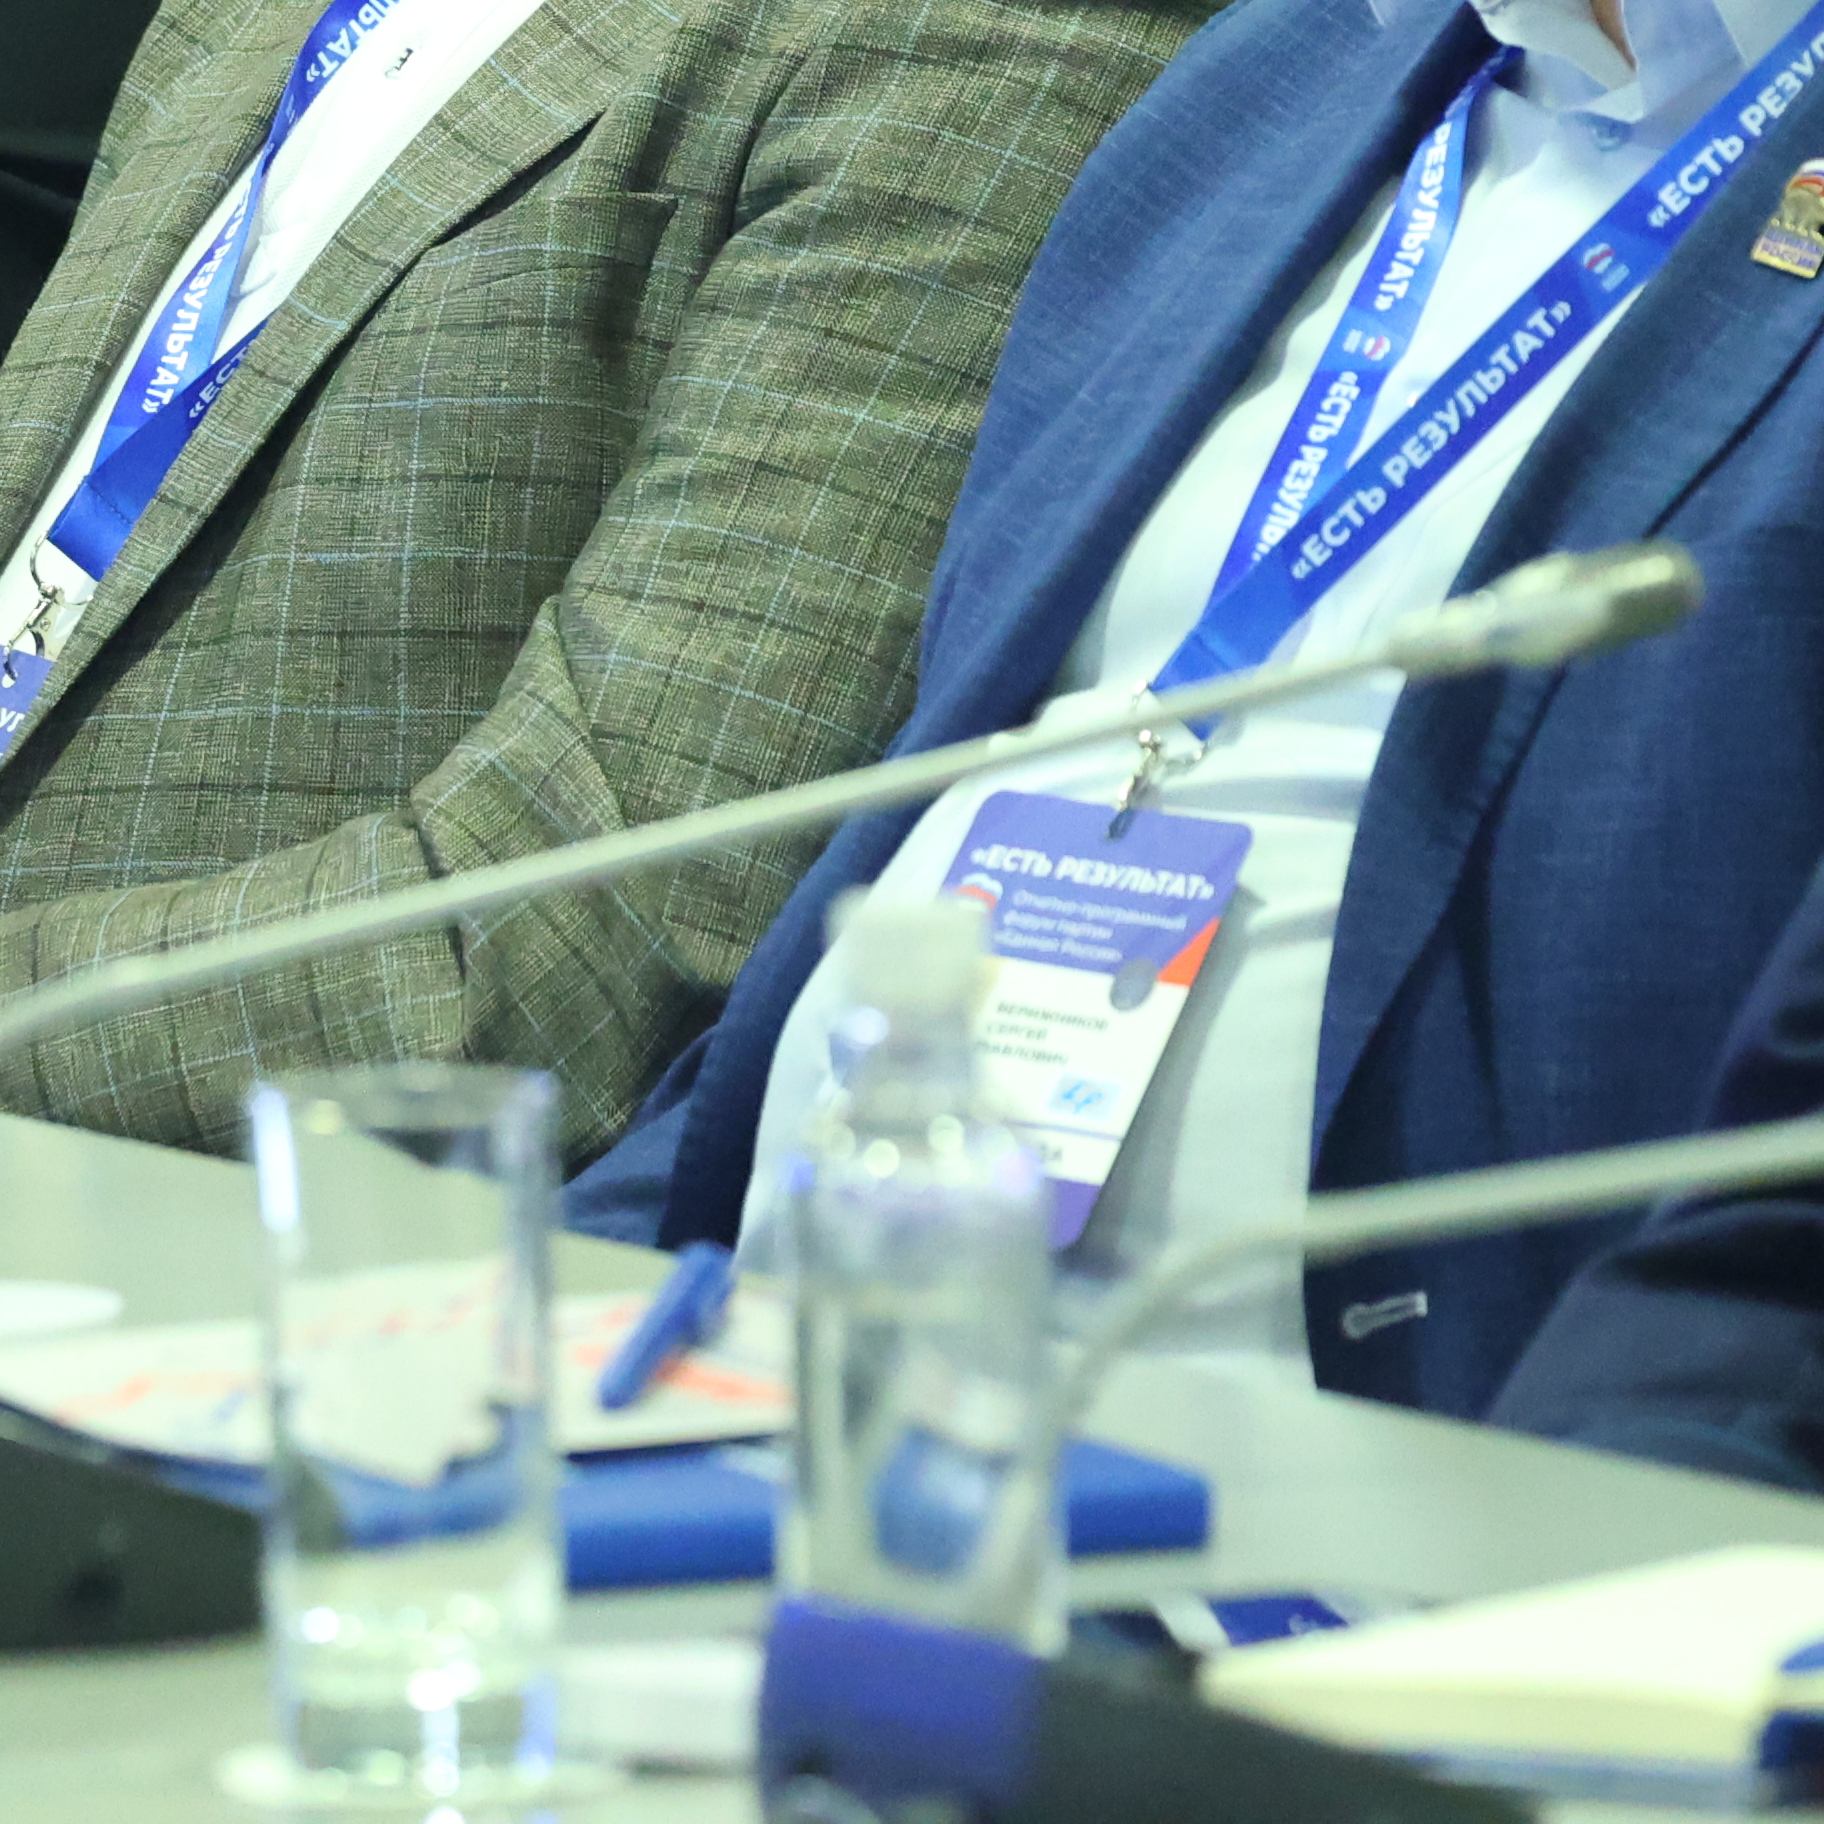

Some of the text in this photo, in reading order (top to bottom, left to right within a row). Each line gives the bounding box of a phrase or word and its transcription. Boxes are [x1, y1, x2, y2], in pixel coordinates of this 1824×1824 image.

[1374, 121, 1453, 311] РЕЗУЛЬТАТ»
[1647, 135, 1745, 228] «ЕСТЬ
[141, 242, 232, 413] РЕЗУЛЬТАТ»
[1291, 300, 1572, 579] «ЕСТЬ РЕЗУЛЬТАТ»
[1307, 370, 1361, 443] «ЕСТЬ
[970, 844, 1215, 899] «ЕСТЬ РЕЗУЛЬТАТ»
